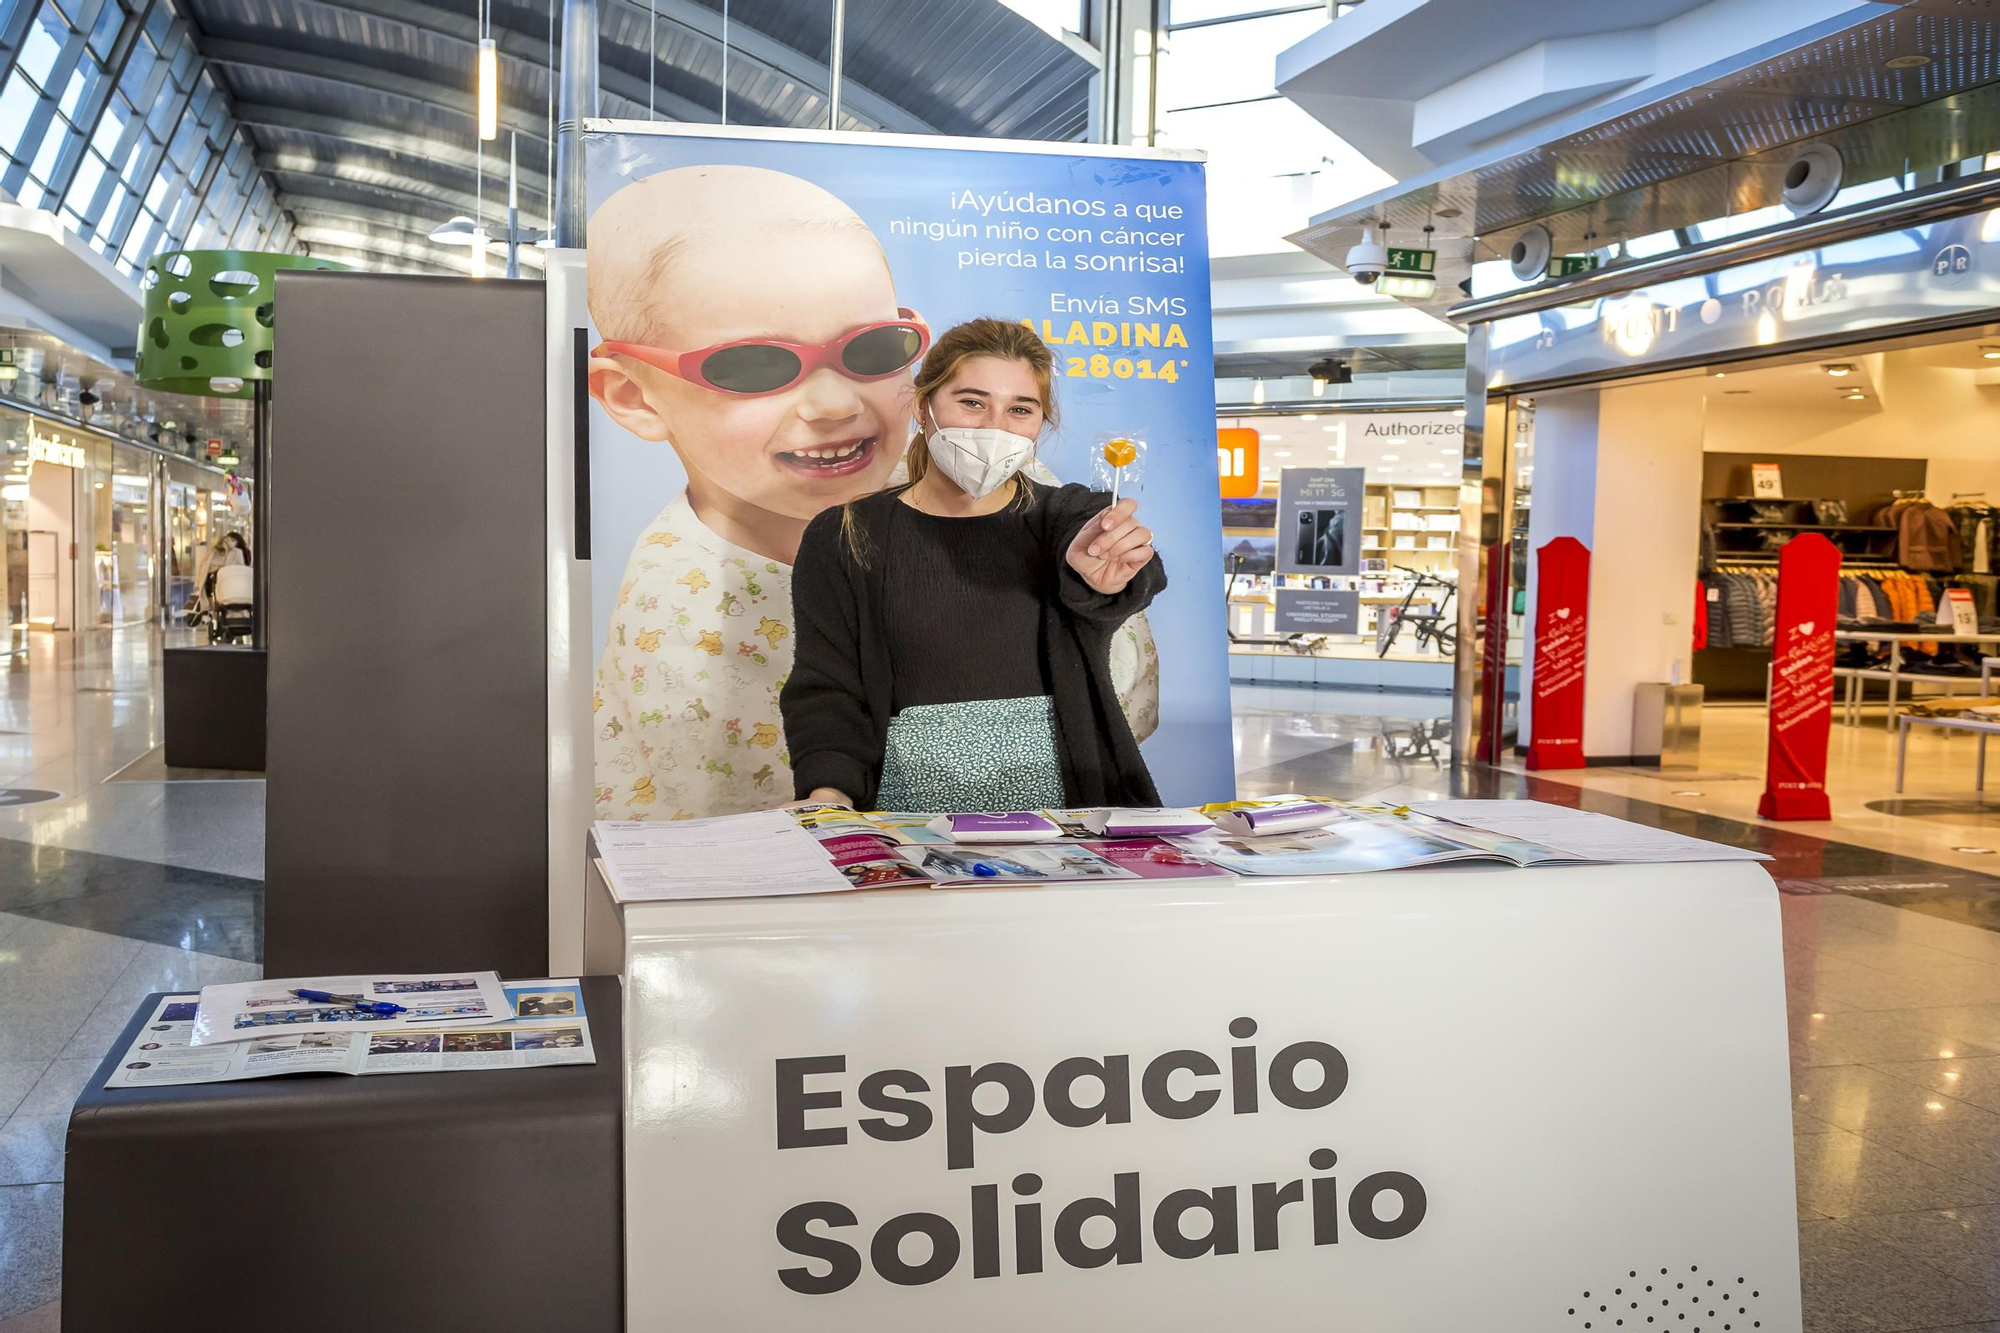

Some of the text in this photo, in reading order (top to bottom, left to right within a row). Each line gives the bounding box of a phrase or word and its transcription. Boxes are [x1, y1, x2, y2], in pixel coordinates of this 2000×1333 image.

[951, 189, 1184, 223] ¡Ayúdanos a que
[889, 217, 1186, 247] ningún niño con cáncer
[957, 249, 1185, 274] pierda la sonrisa!
[1051, 293, 1187, 316] Envía SMS
[1330, 488, 1345, 497] 5G
[775, 1016, 1349, 1169] Espacio
[775, 1147, 1428, 1295] Solidario
